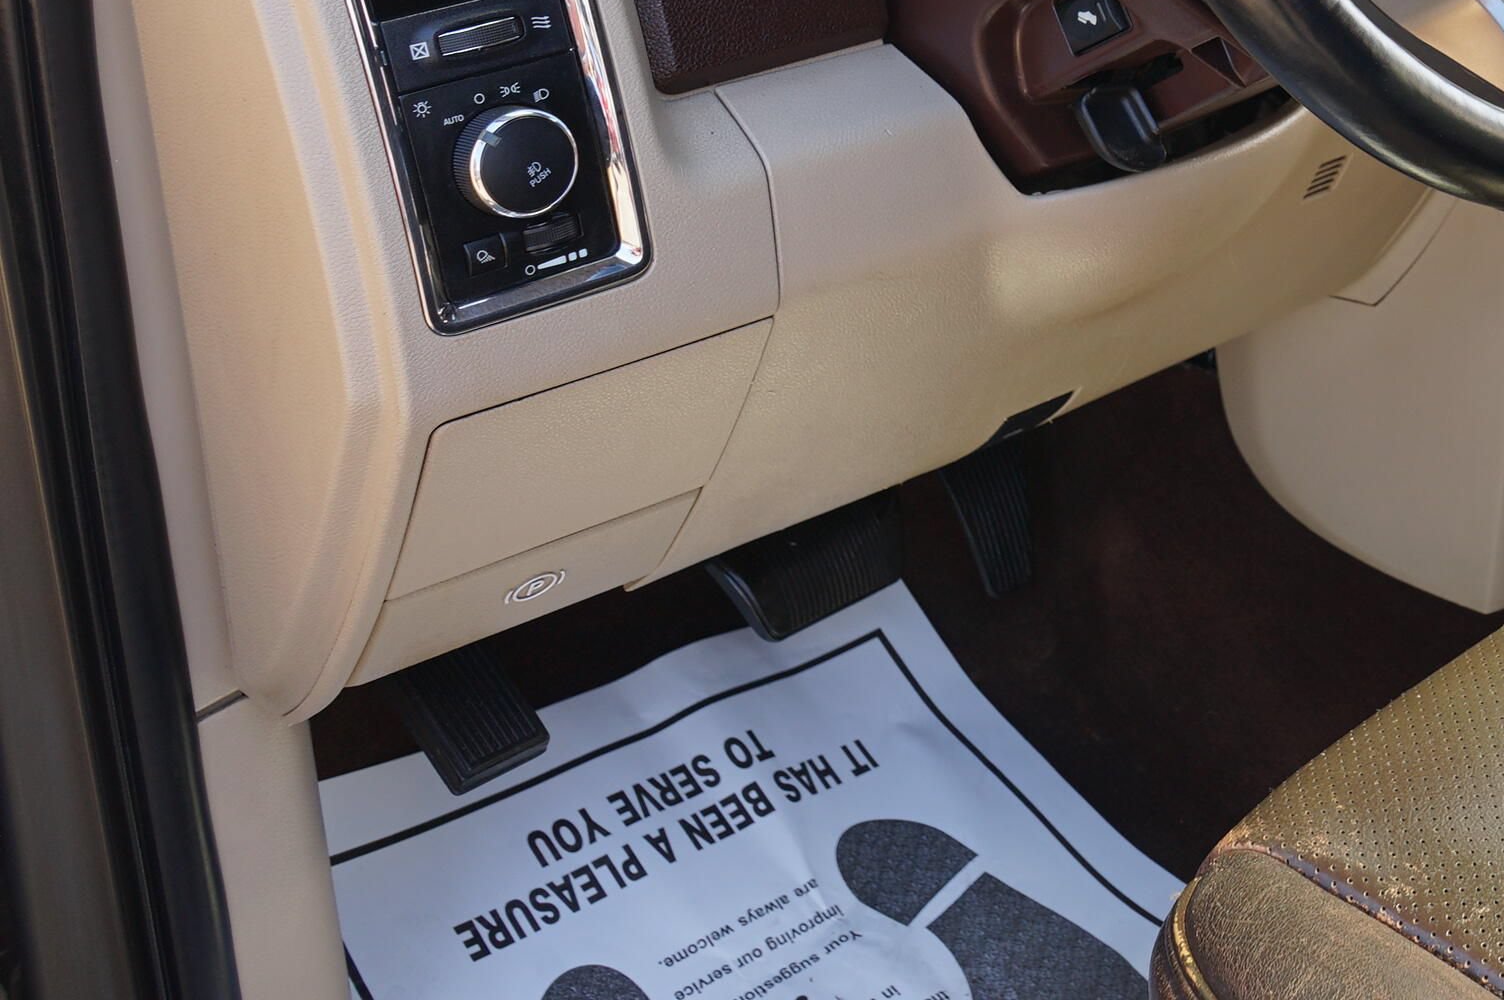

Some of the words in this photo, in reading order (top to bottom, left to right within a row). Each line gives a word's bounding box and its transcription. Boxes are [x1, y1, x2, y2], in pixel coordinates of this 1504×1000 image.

[443, 114, 465, 127] AUTO
[528, 168, 552, 188] PUSH
[723, 729, 776, 769] TO
[840, 739, 880, 777] IT
[606, 754, 721, 827] SERVE
[773, 755, 843, 803] HAS
[678, 781, 776, 851] BEEN
[527, 807, 612, 868] YOU
[643, 827, 677, 864] A
[453, 844, 648, 962] PLEASURE
[794, 877, 819, 897] are
[738, 894, 791, 928] always
[765, 904, 845, 951] improving
[658, 925, 735, 969] welcome.
[737, 947, 763, 969] our
[823, 929, 863, 955] Your
[673, 963, 733, 1000] service
